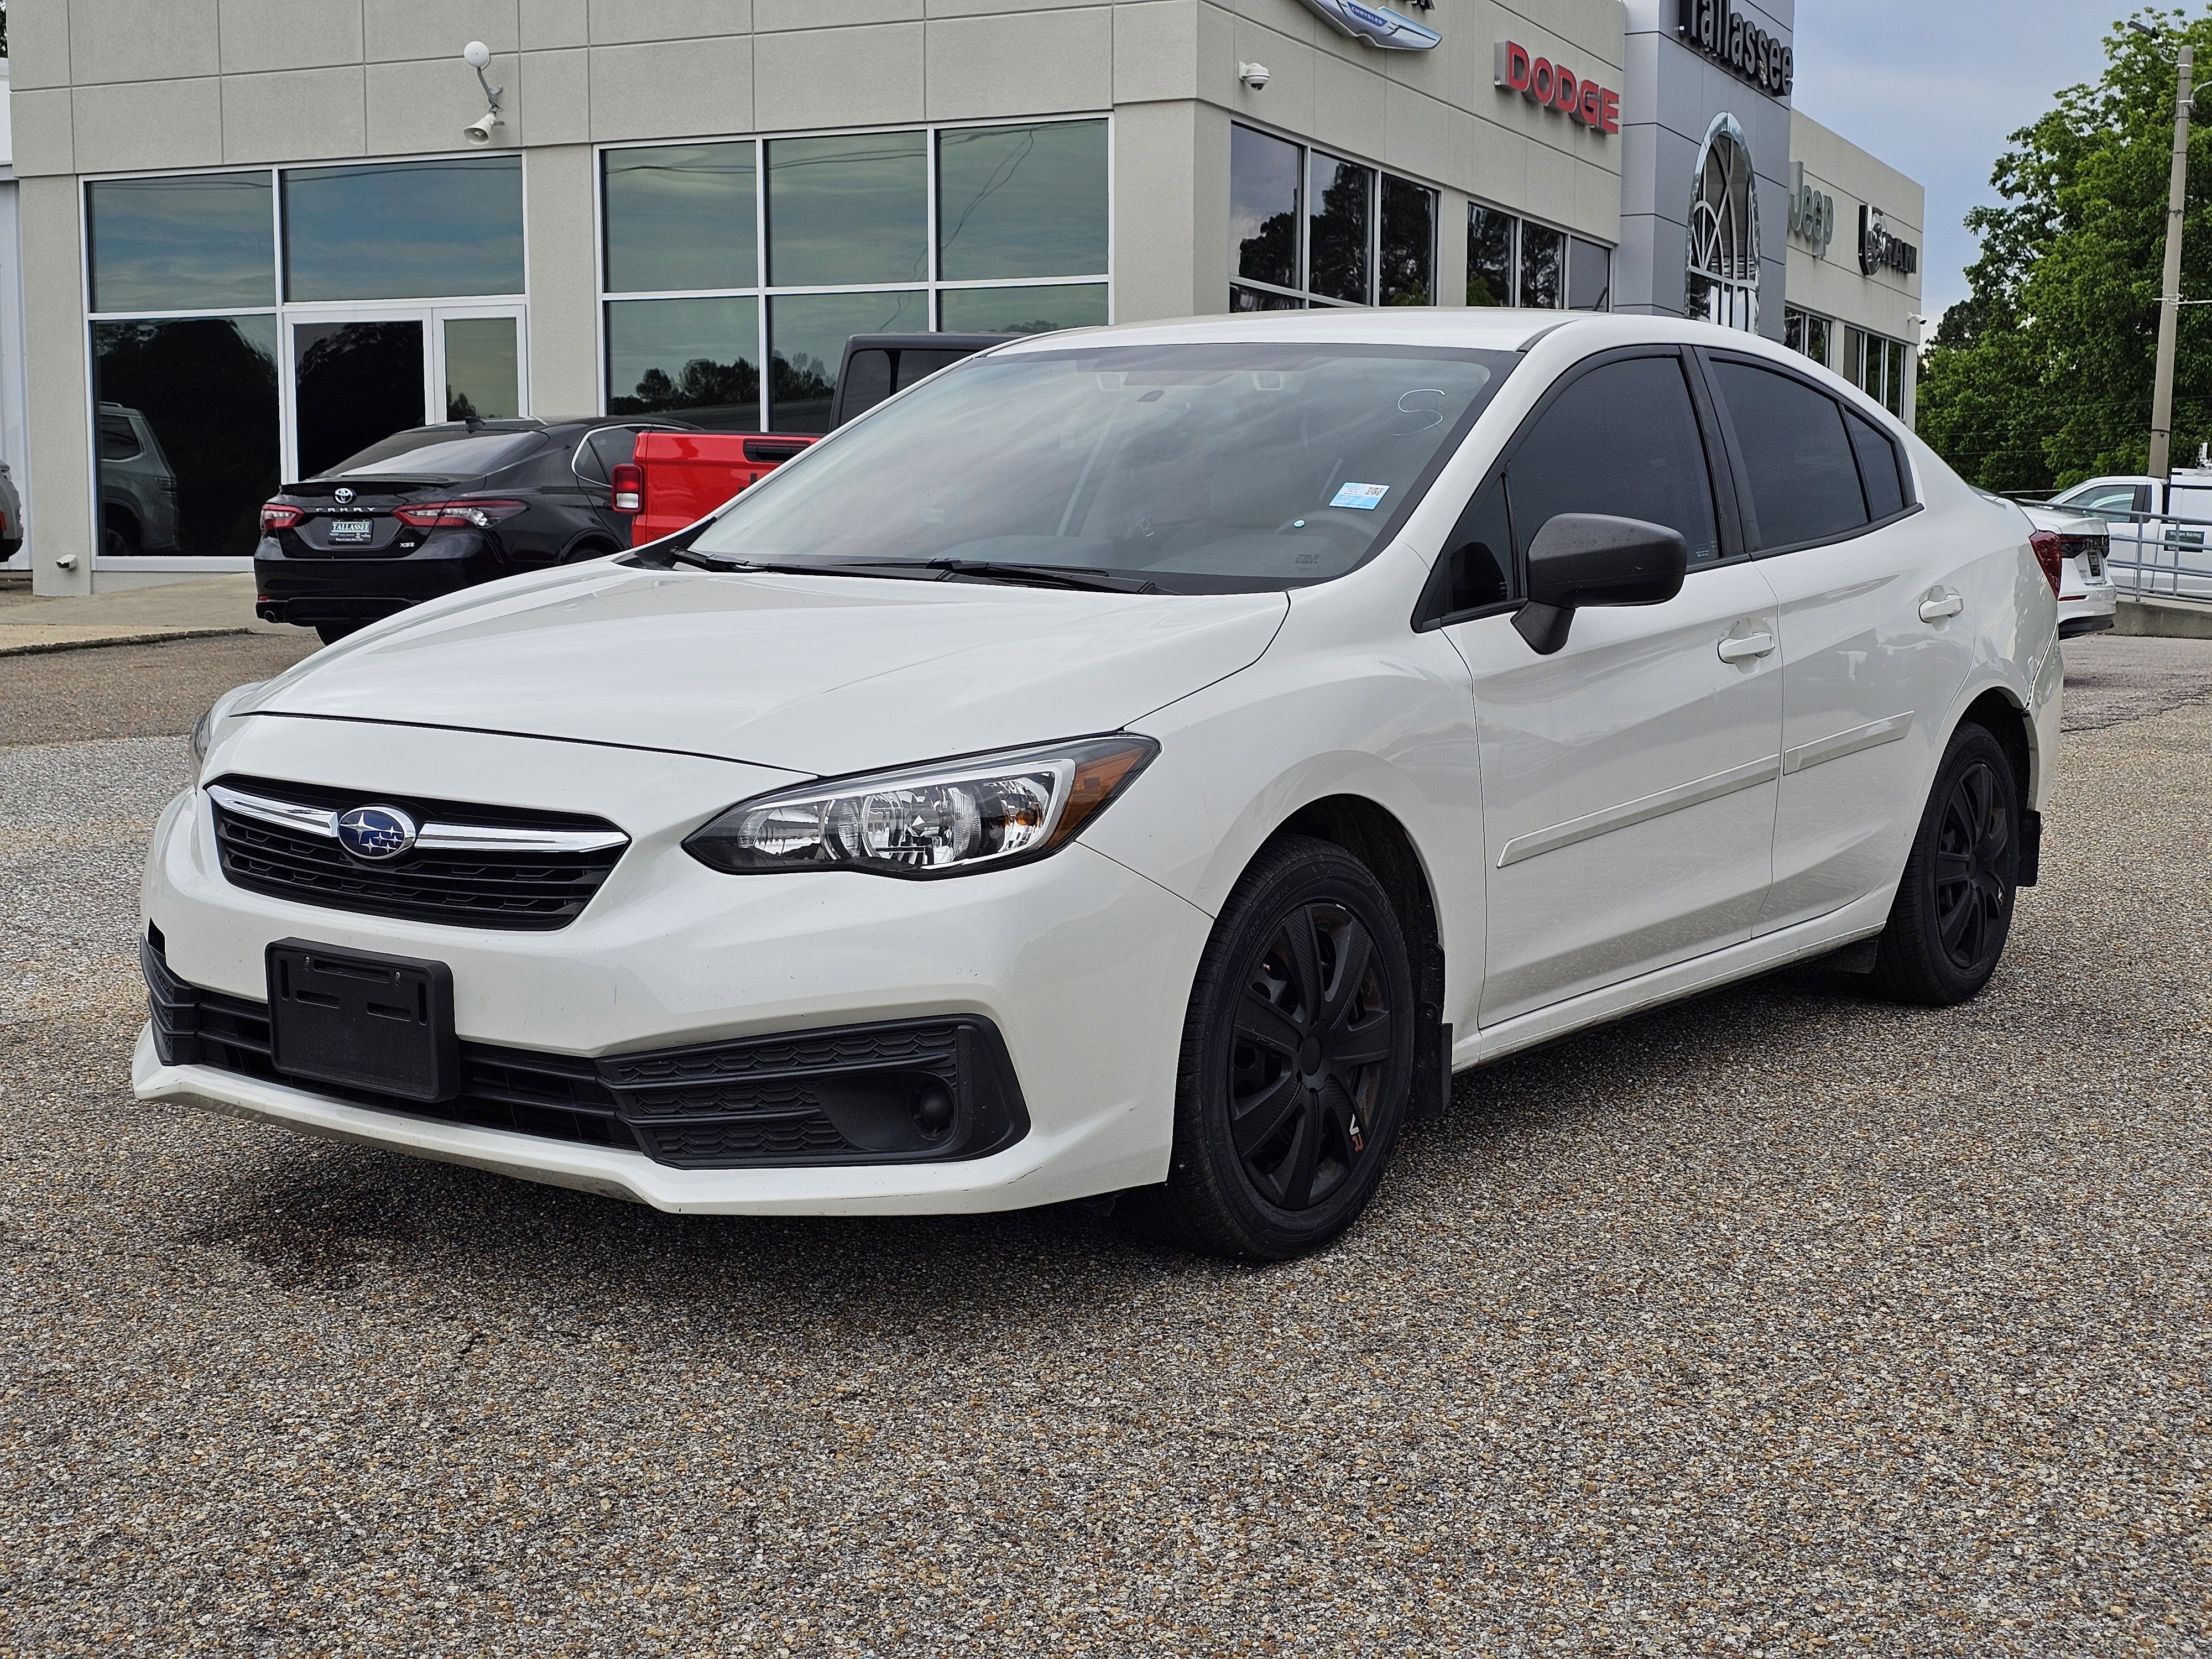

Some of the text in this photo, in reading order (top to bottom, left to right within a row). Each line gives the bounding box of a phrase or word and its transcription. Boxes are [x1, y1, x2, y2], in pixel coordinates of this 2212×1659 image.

[1351, 6, 1383, 25] CHRYSLER
[1504, 40, 1620, 134] DODGE
[1788, 160, 1834, 258] Jeep
[1881, 231, 1917, 274] RAM
